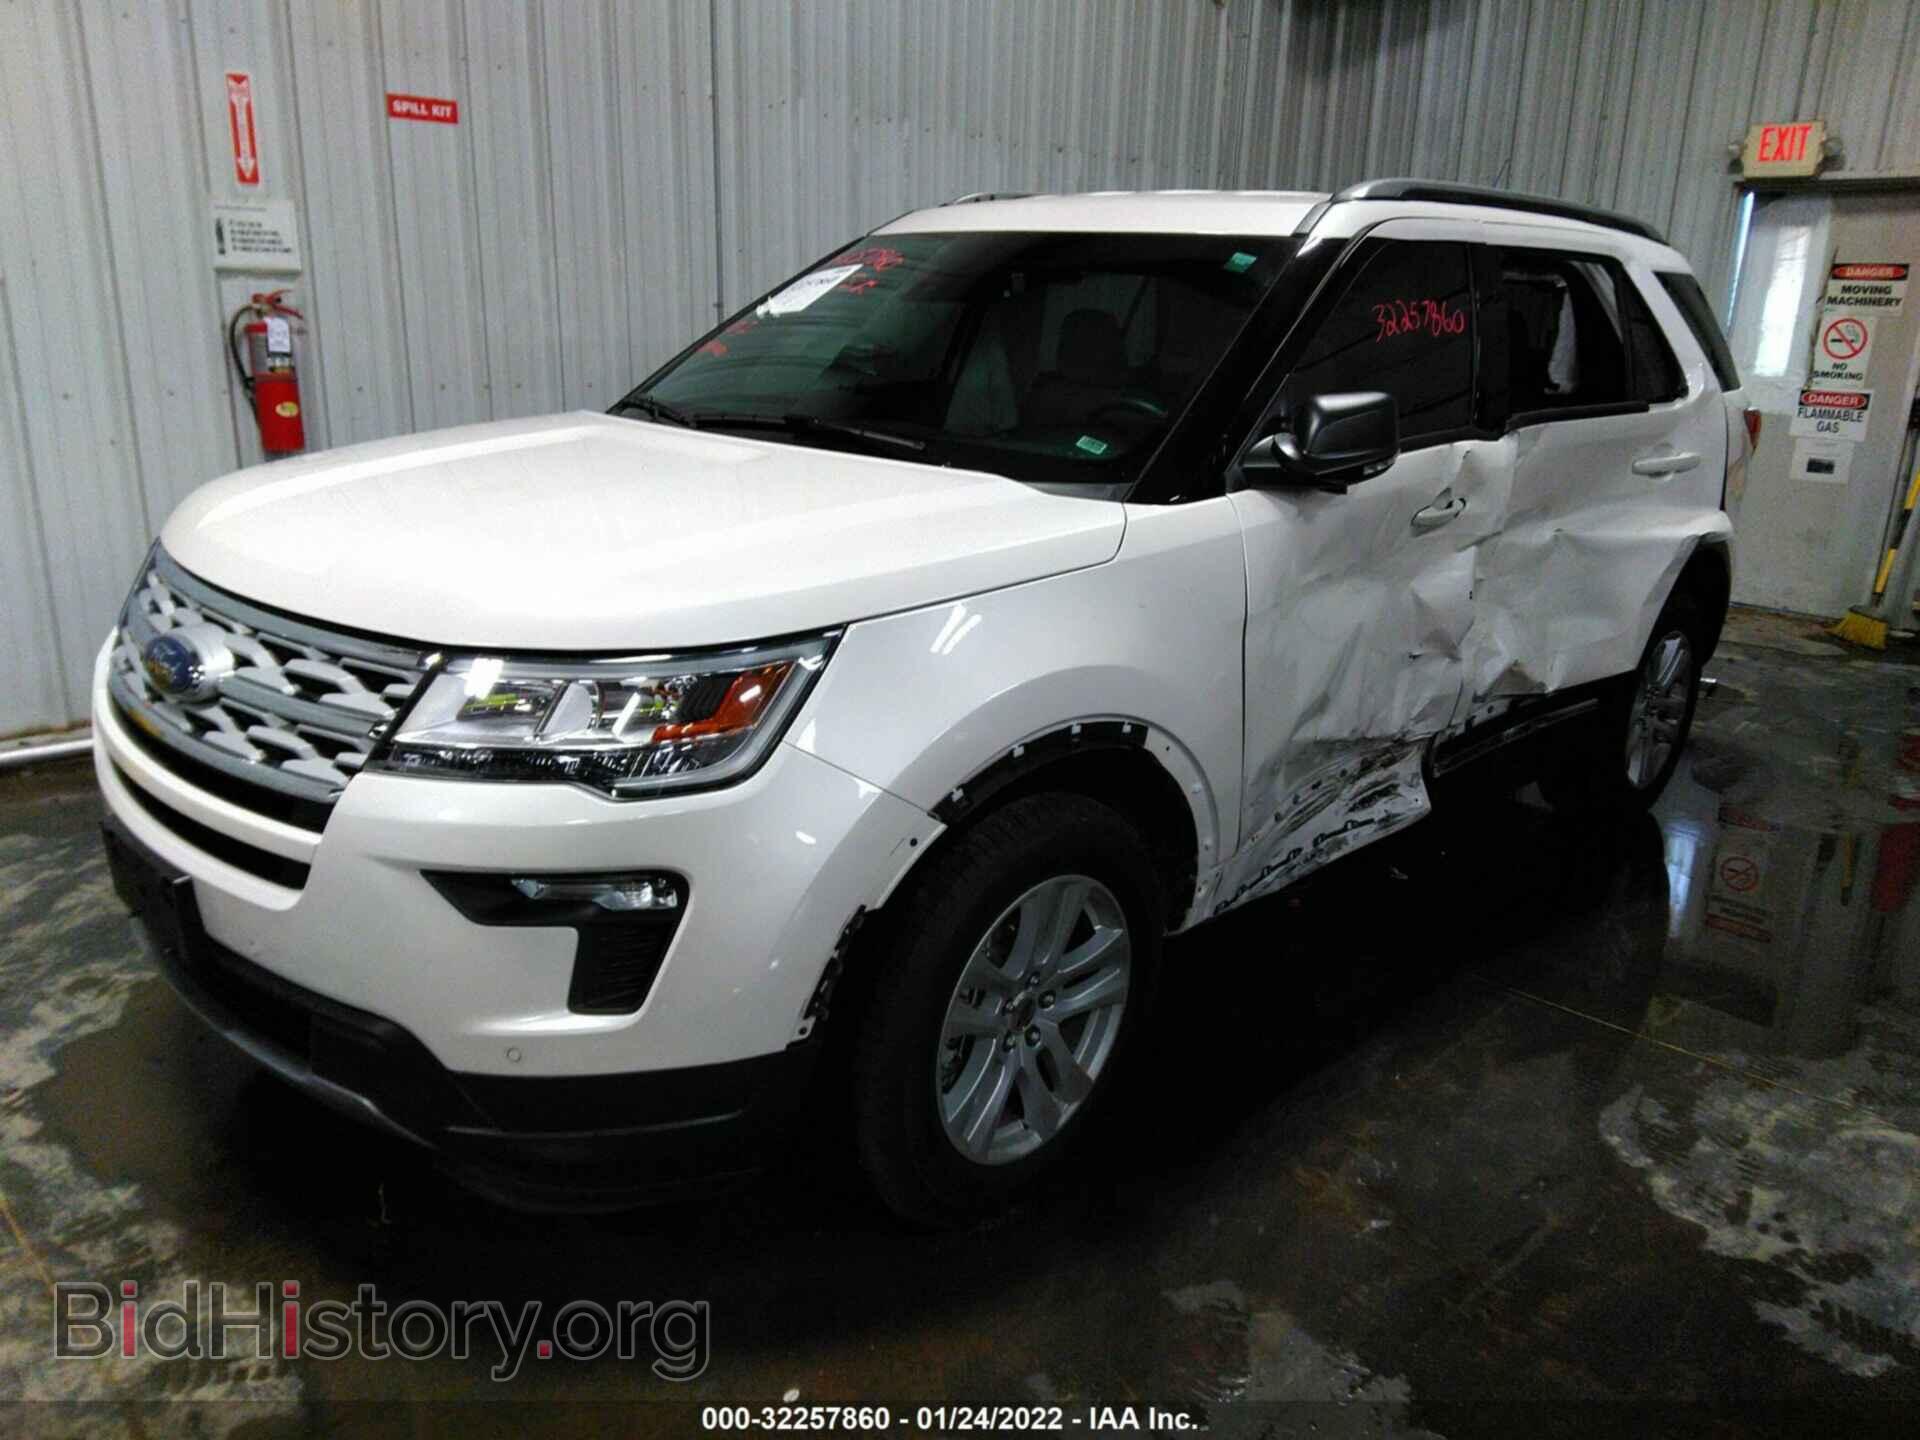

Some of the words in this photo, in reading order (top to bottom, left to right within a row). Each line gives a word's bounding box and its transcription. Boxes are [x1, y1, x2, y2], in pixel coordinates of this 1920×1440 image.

[393, 99, 429, 116] SPILL
[431, 104, 453, 117] KIT
[1757, 124, 1813, 162] EXIT
[1845, 265, 1894, 278] DANGER
[1840, 285, 1892, 295] MOVING
[1826, 295, 1903, 306] MACHINERY
[1371, 299, 1465, 343] 32257860
[1832, 362, 1848, 371] NO
[1813, 370, 1863, 380] SMOKING
[1808, 393, 1858, 406] DANGER
[1797, 407, 1864, 422] FLAMMABLE
[1816, 420, 1840, 433] GAS
